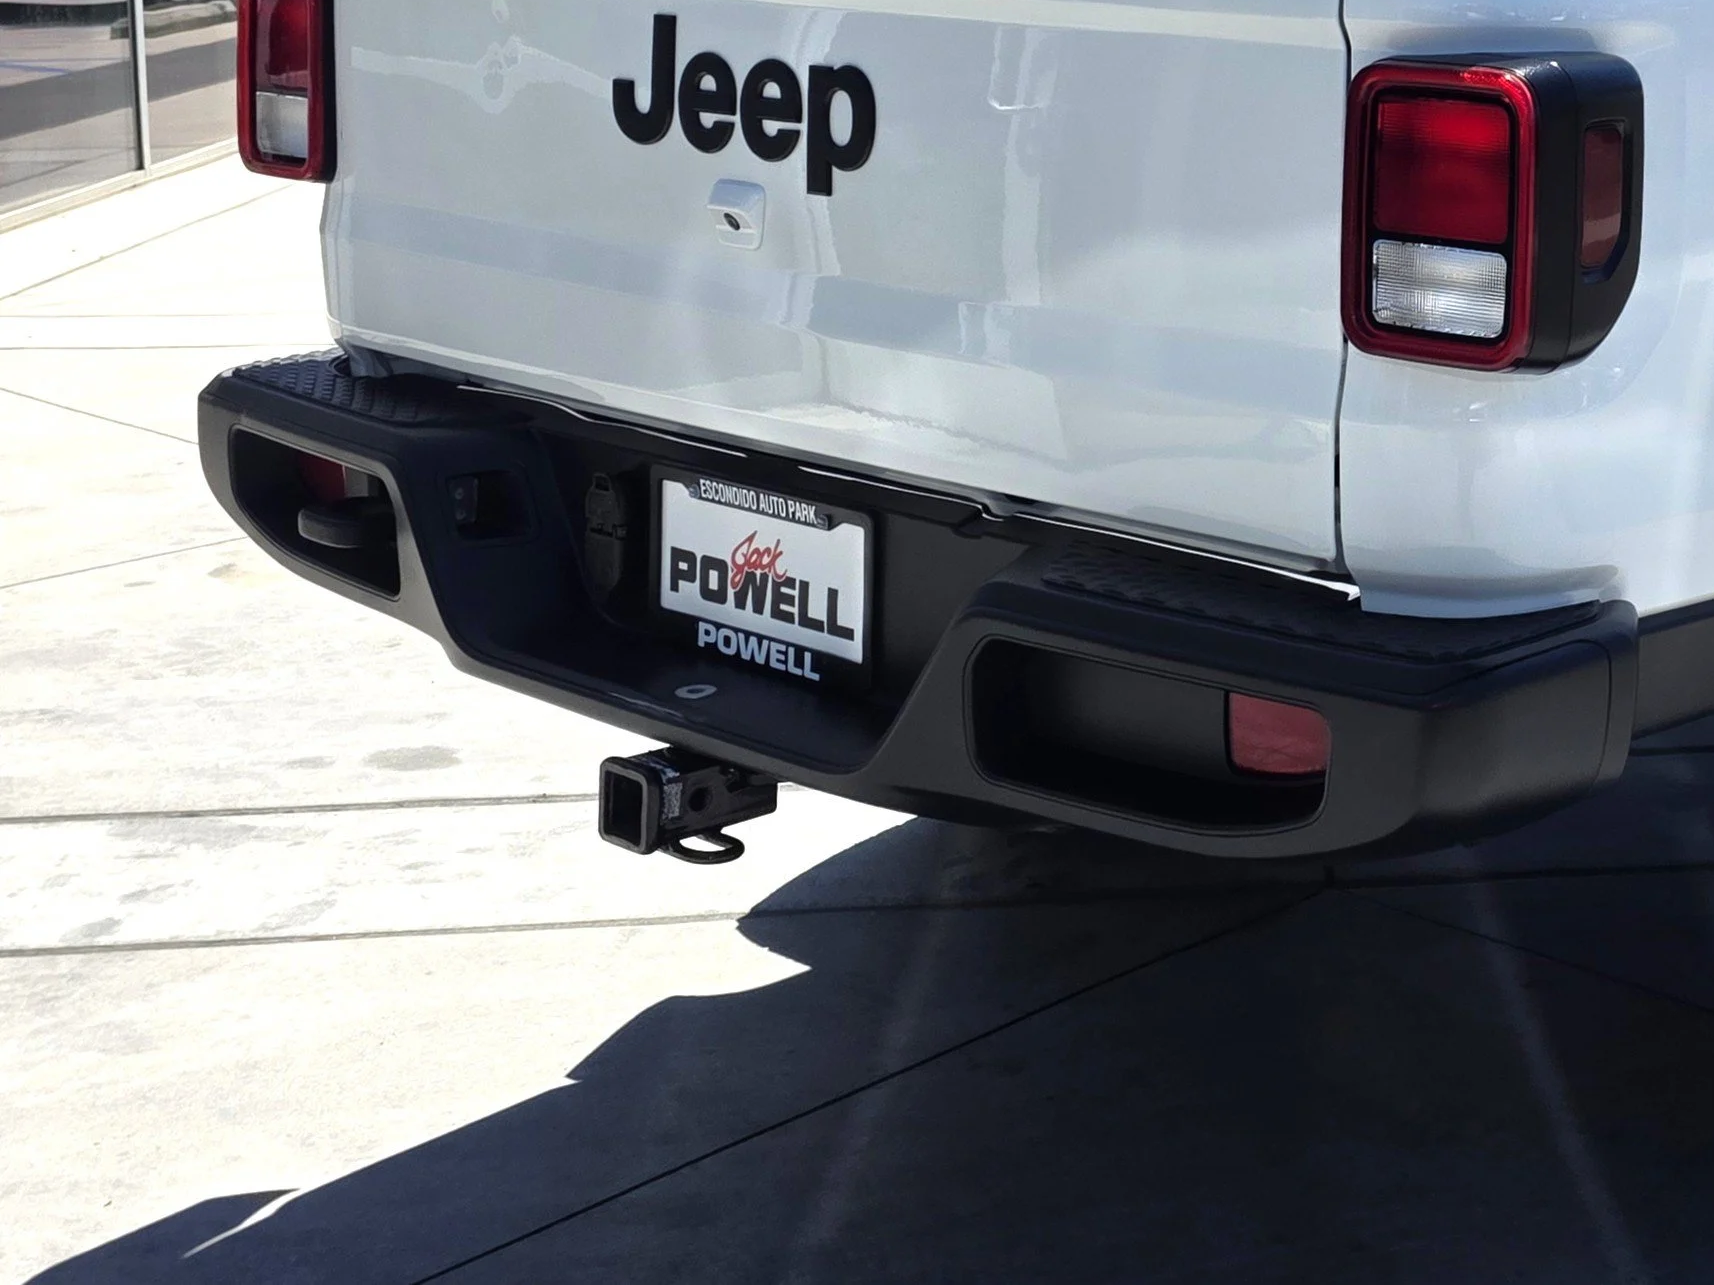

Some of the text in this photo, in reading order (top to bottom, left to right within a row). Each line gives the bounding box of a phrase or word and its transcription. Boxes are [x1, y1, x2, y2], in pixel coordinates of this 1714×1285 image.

[612, 13, 876, 197] Jeep
[699, 478, 818, 526] ESCONDIDO AUTO PARK
[730, 530, 788, 591] Jack
[670, 546, 854, 642] POWELL
[697, 620, 821, 682] POWELL
